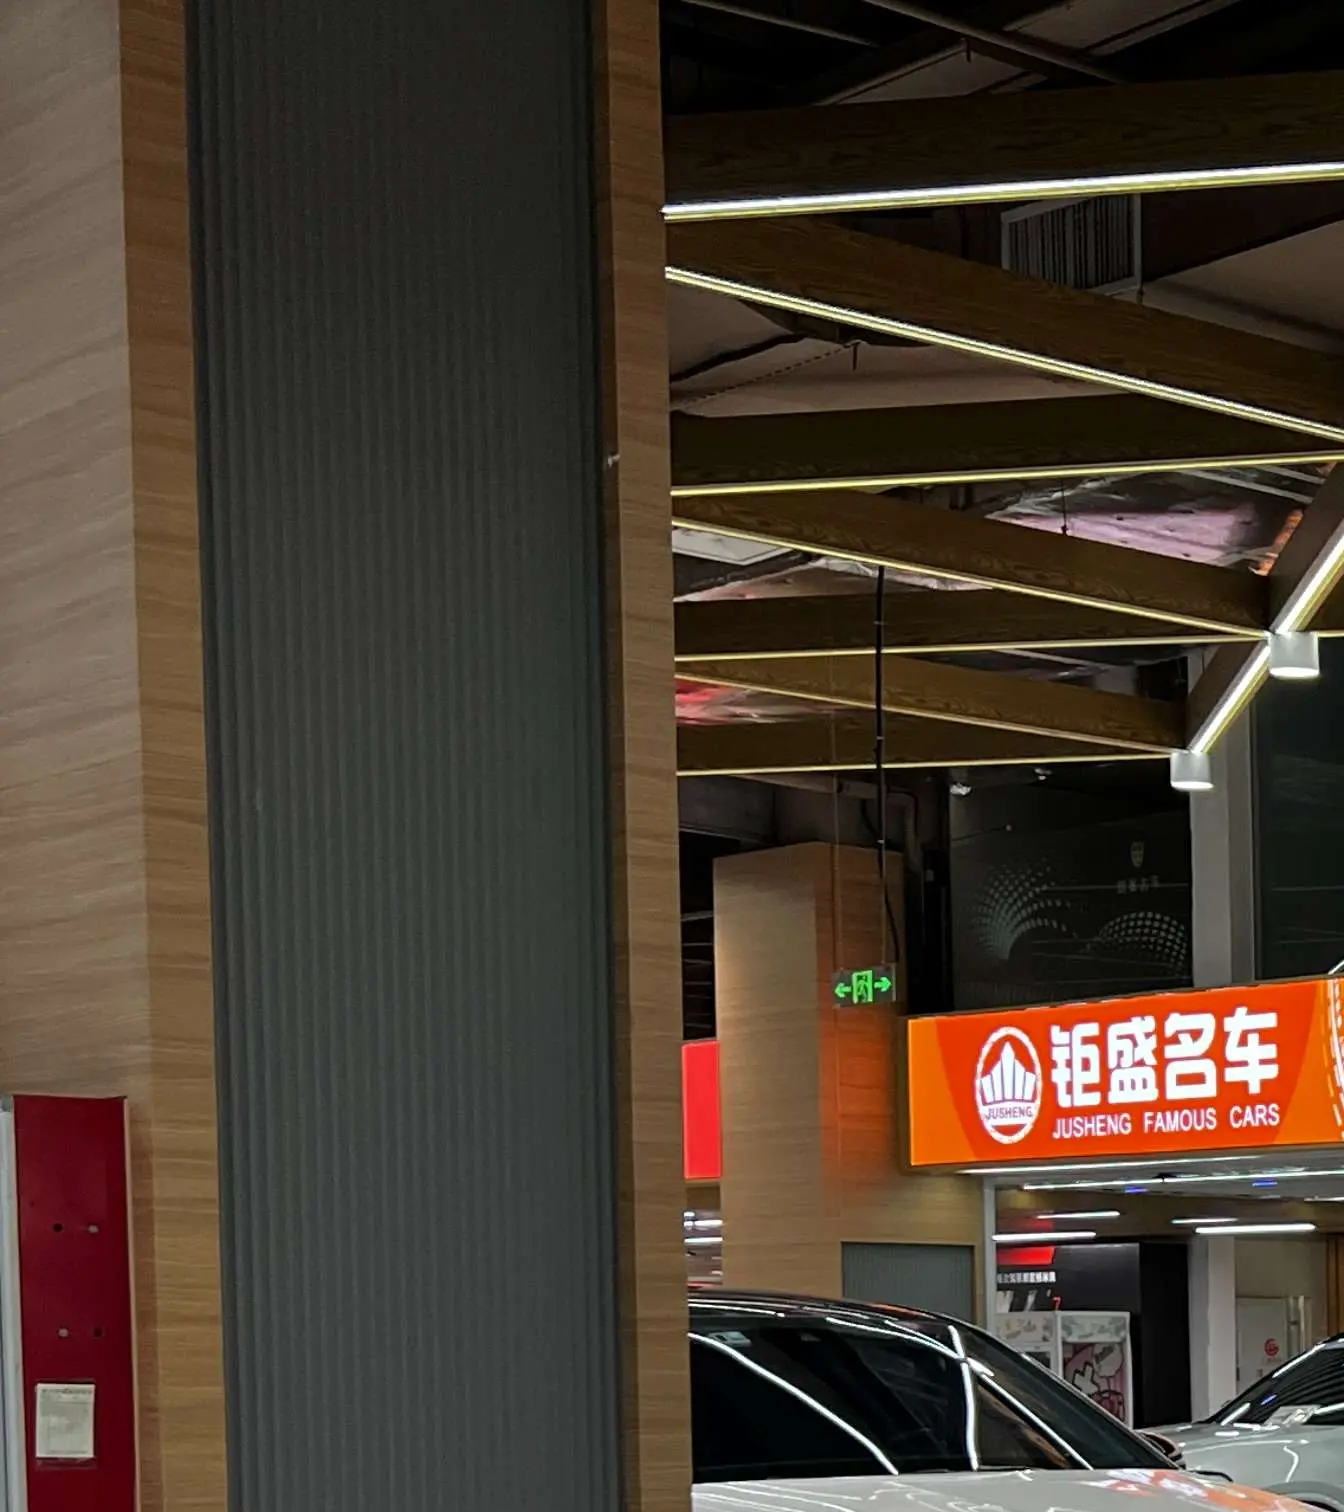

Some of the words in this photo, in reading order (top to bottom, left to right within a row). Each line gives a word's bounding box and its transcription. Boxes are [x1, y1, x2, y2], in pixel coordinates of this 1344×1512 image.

[1050, 1006, 1279, 1108] 钜盛名车
[983, 1106, 1034, 1121] JUSHENG
[1052, 1111, 1132, 1140] JUSHENG
[1143, 1107, 1218, 1133] FAMOUS
[1229, 1103, 1281, 1129] CARS
